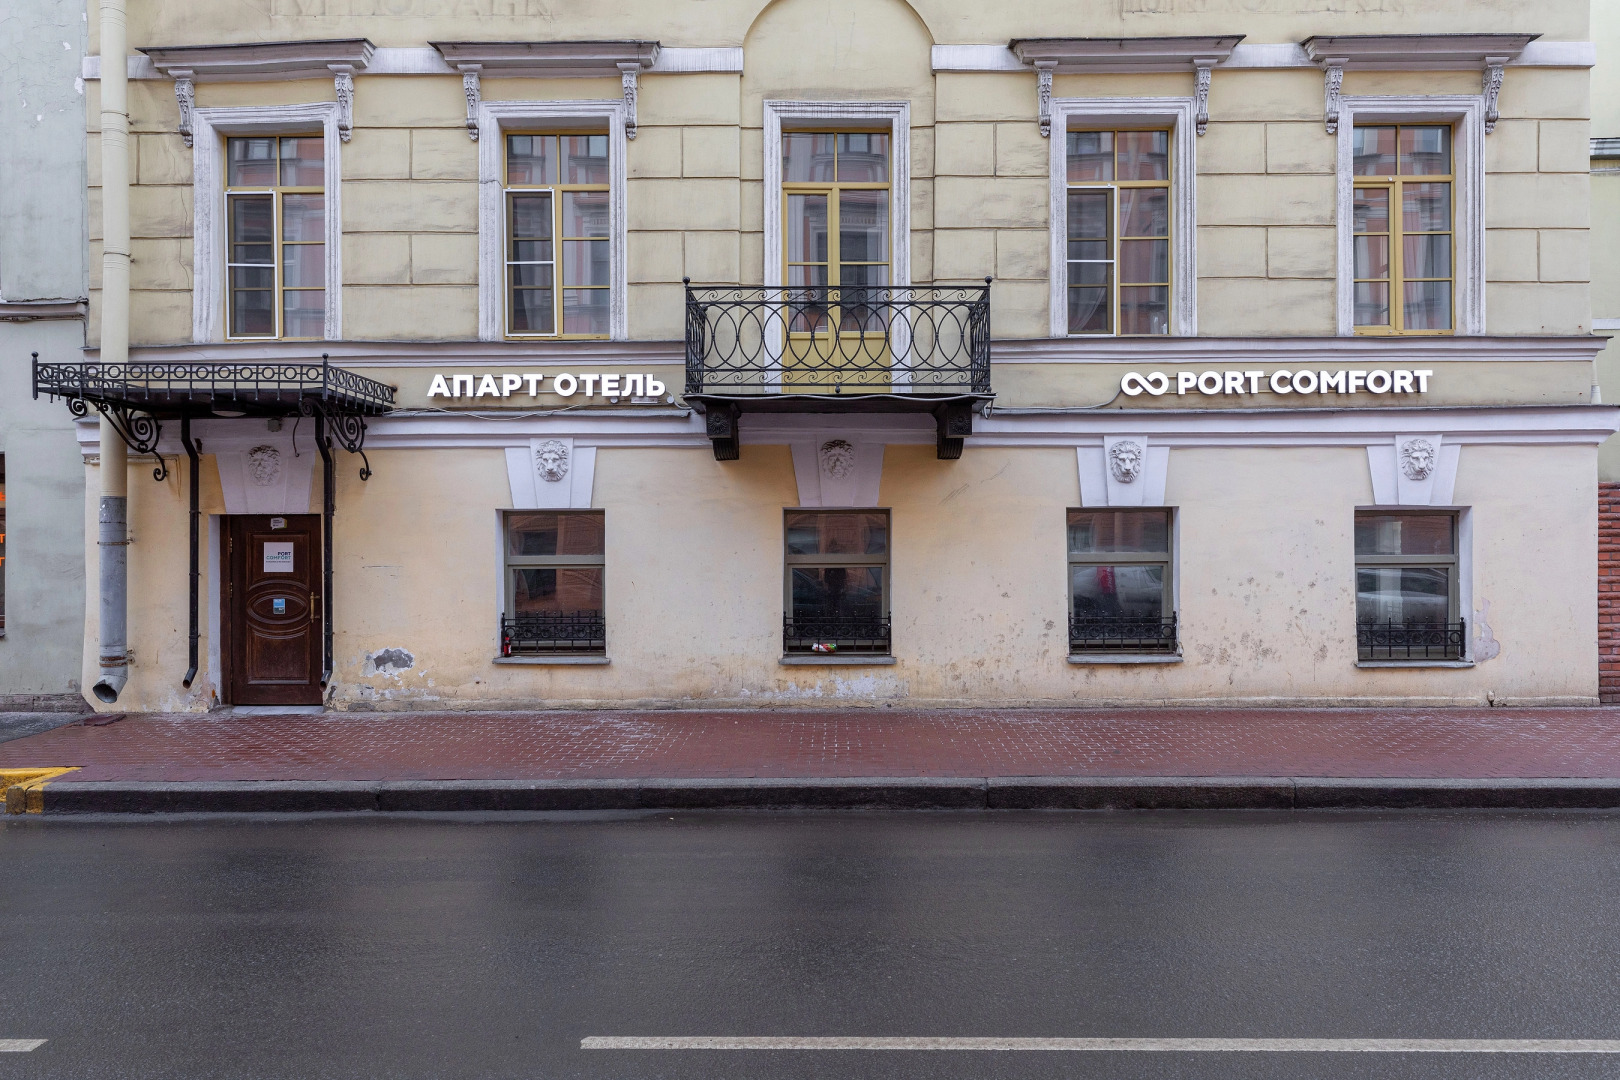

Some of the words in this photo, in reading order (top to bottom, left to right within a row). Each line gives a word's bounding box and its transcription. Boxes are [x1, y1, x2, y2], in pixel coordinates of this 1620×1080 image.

[427, 373, 544, 397] АПАРТ
[553, 373, 667, 397] ОТЕЛЬ
[1177, 371, 1264, 395] PORT
[1269, 369, 1433, 395] COMFORT
